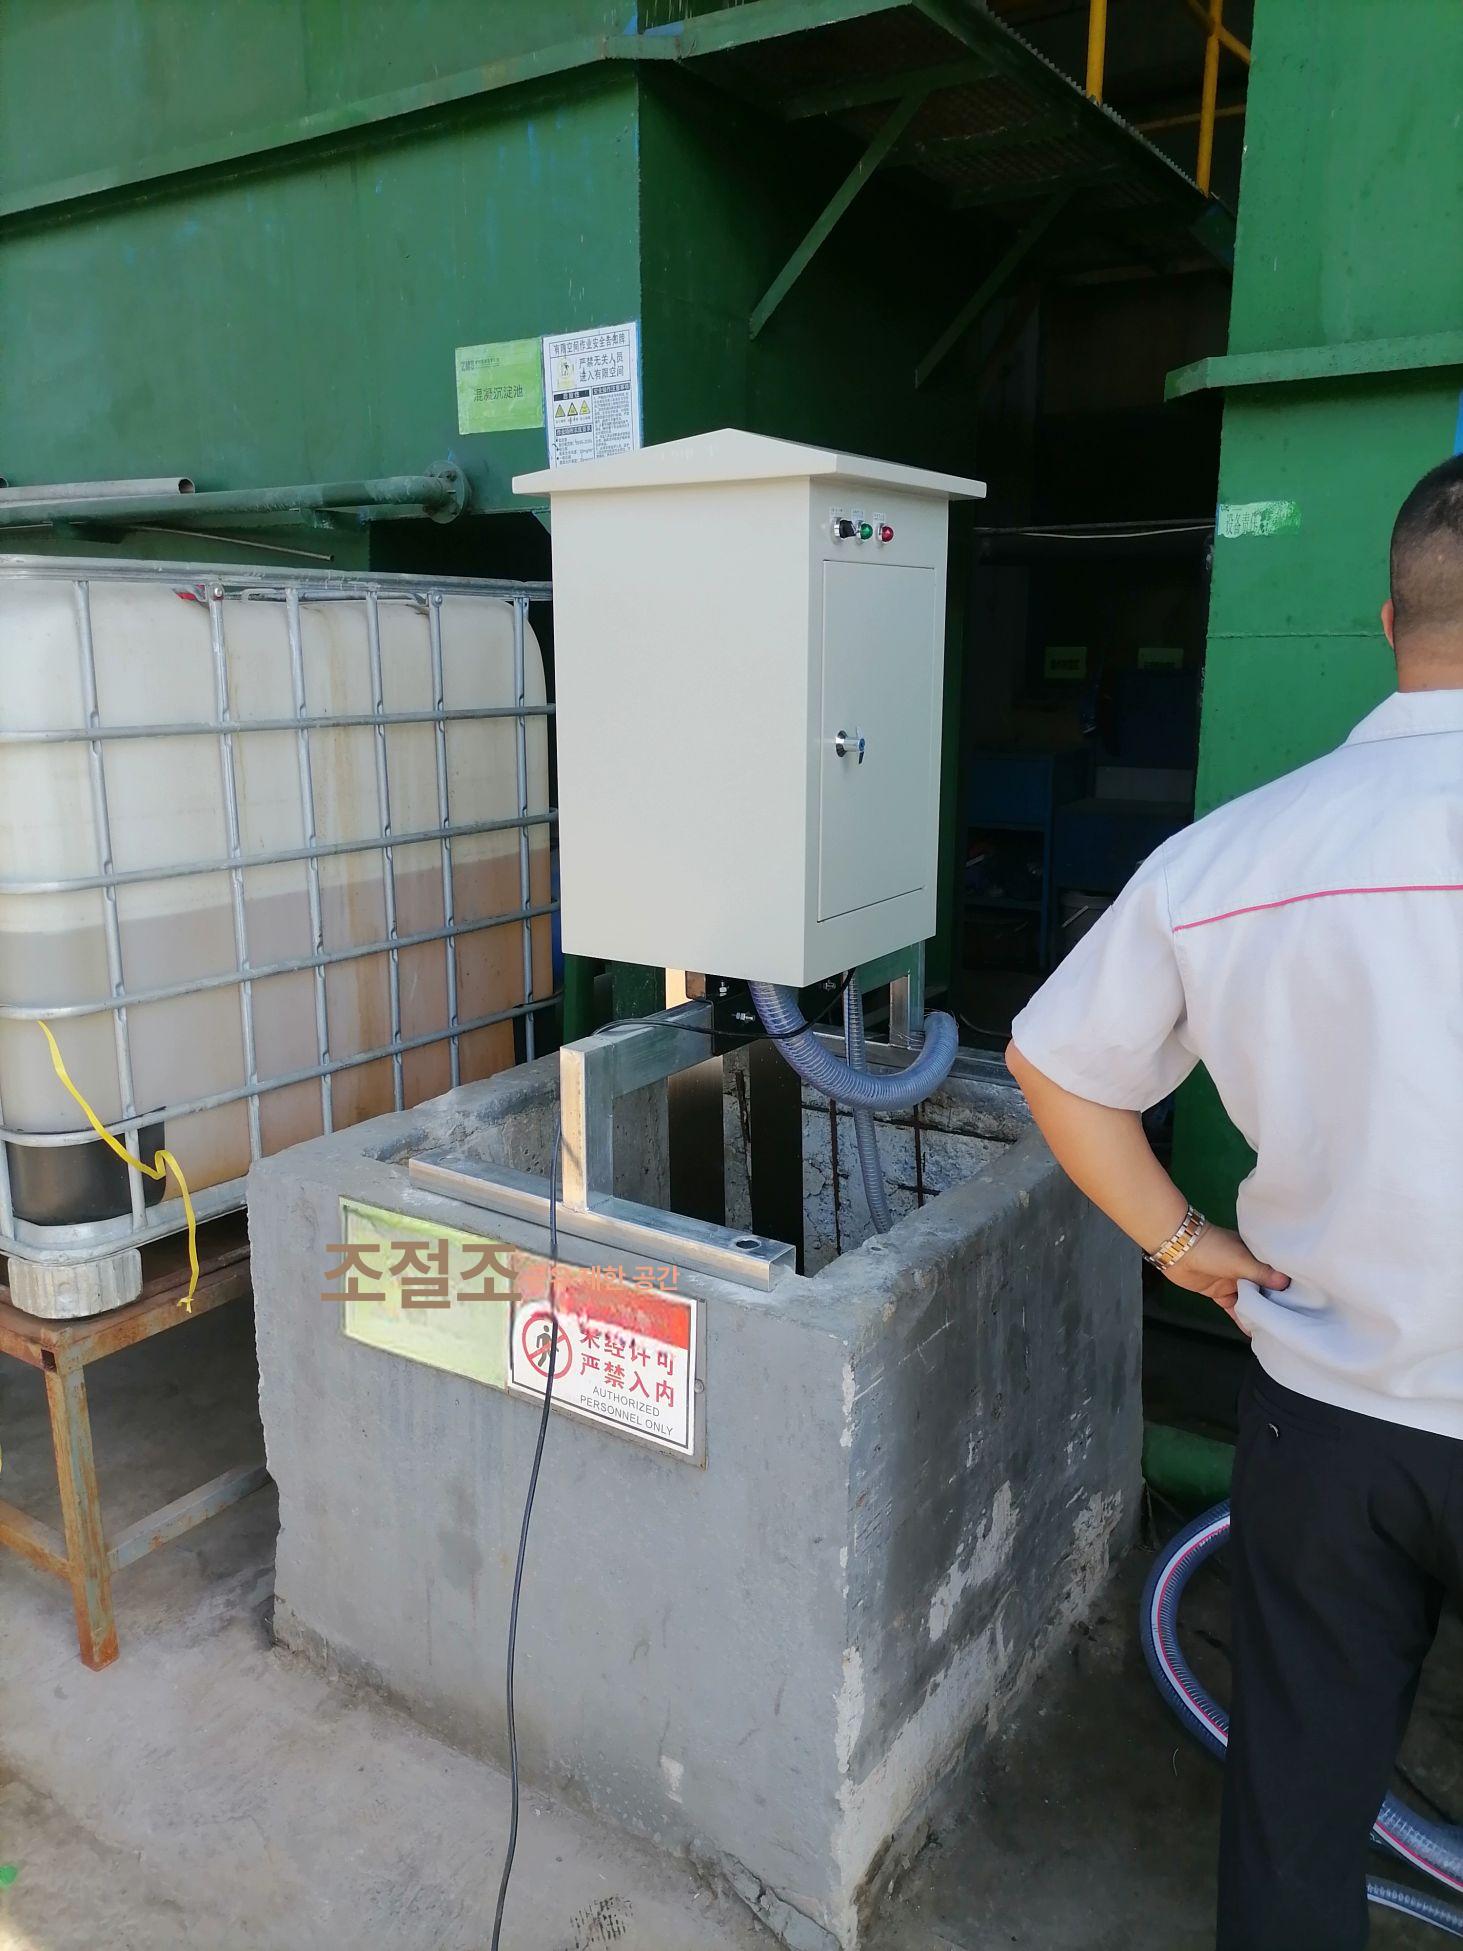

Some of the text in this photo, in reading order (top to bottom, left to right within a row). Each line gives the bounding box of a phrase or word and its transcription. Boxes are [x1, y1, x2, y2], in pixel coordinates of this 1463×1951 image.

[579, 352, 624, 369] 严禁无关人员
[579, 366, 625, 382] 进入有限空间
[473, 384, 524, 402] 混凝沉淀池
[579, 1352, 675, 1408] 严禁入内
[593, 1386, 660, 1417] AUTHORIZED
[580, 1395, 673, 1436] PERSONNEL ONLY
